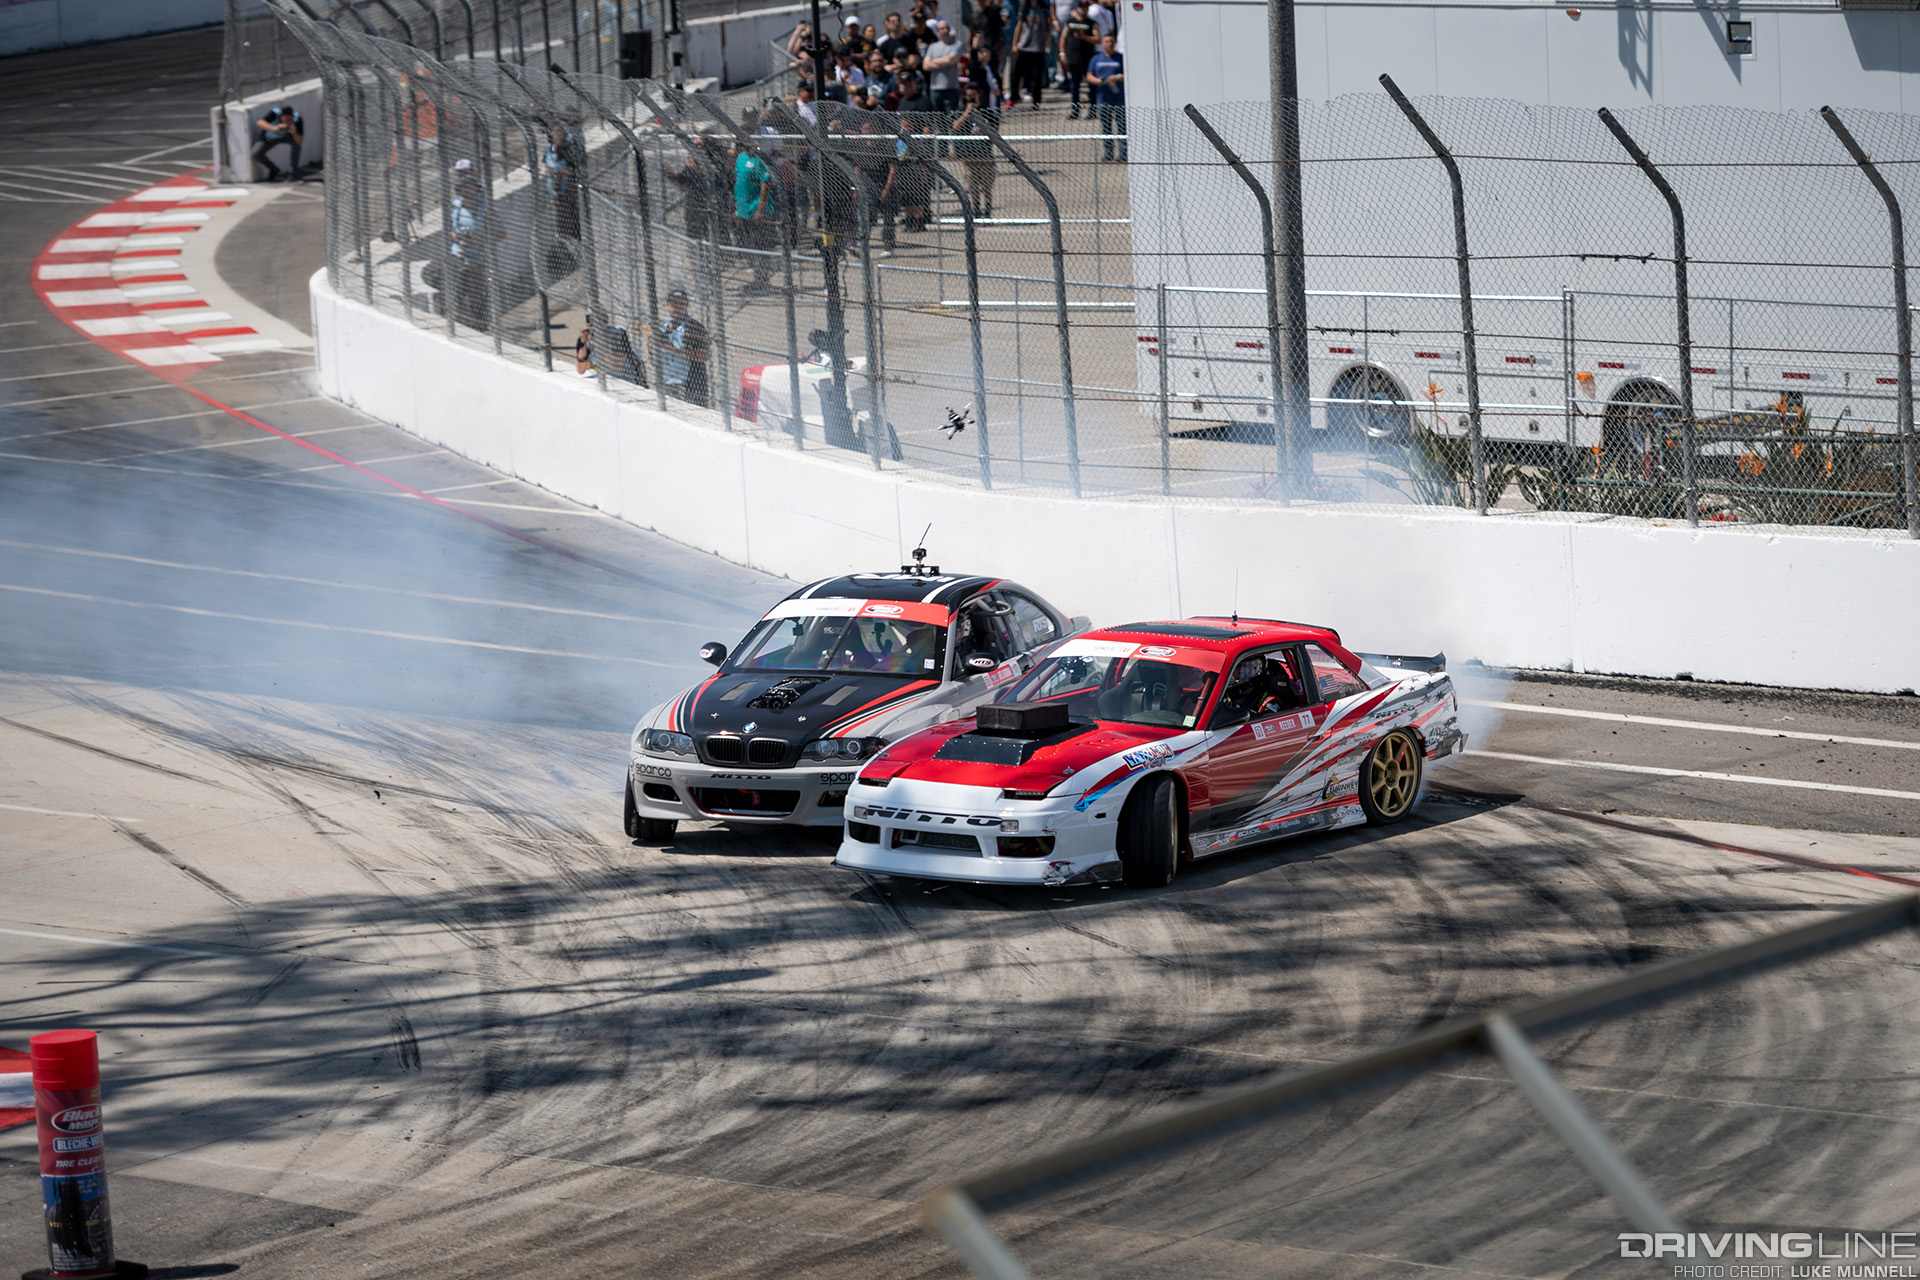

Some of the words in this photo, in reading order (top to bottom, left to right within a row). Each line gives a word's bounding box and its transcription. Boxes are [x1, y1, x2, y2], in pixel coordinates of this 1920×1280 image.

[1375, 704, 1416, 719] NITTO
[1302, 714, 1311, 726] 77
[636, 763, 672, 778] sparco
[820, 771, 857, 786] spar
[866, 804, 1003, 827] NITTO
[55, 1160, 75, 1169] TIRE
